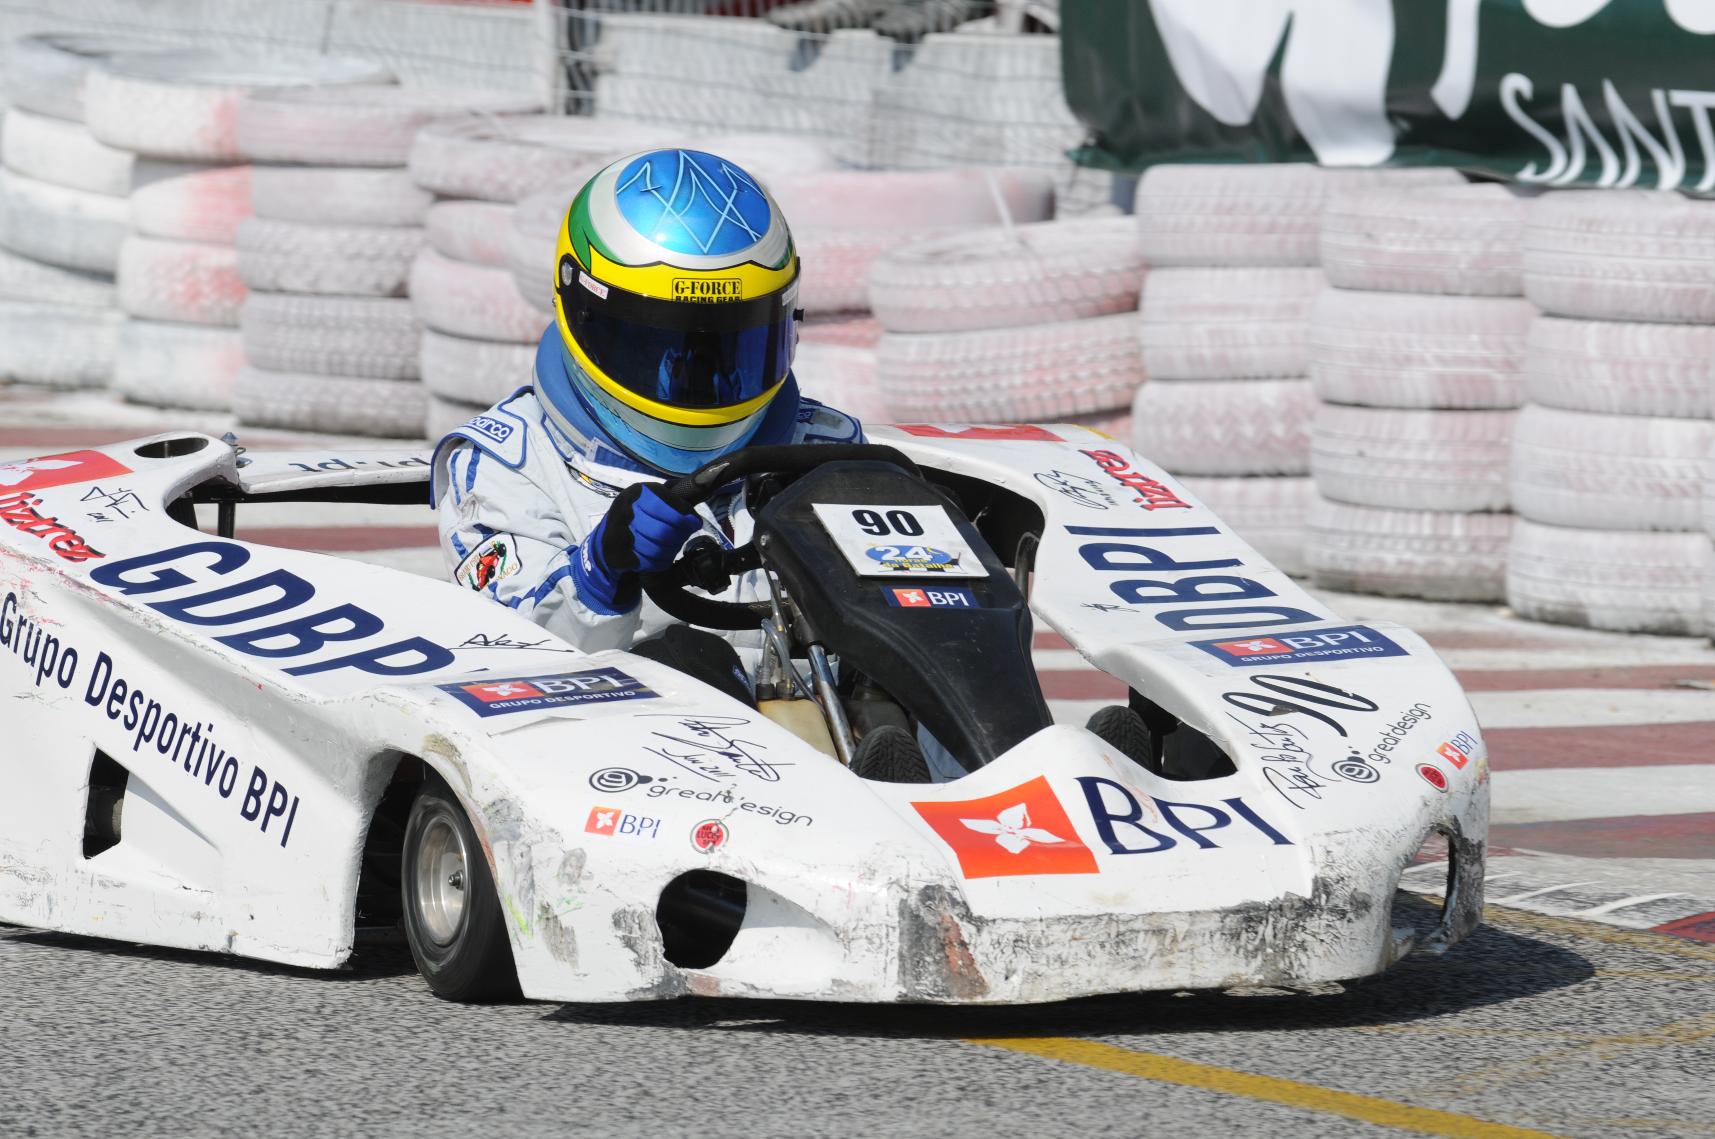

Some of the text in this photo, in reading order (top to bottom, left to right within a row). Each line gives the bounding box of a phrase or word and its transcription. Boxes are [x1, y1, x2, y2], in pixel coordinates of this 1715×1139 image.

[674, 280, 741, 295] G-FORCE
[851, 509, 924, 536] 90
[875, 546, 934, 561] 24
[926, 591, 970, 606] BPI
[1281, 630, 1373, 650] BPI
[1240, 646, 1385, 662] GRUPO DESPORTIVO
[530, 675, 625, 694] BPI
[489, 690, 637, 709] GRUPO DESPORTIVO
[1222, 674, 1380, 738] 90
[0, 591, 300, 848] Grupo Desportivo BPI
[1451, 730, 1478, 755] BPI
[1073, 776, 1296, 856] BPI
[619, 814, 661, 839] BPI
